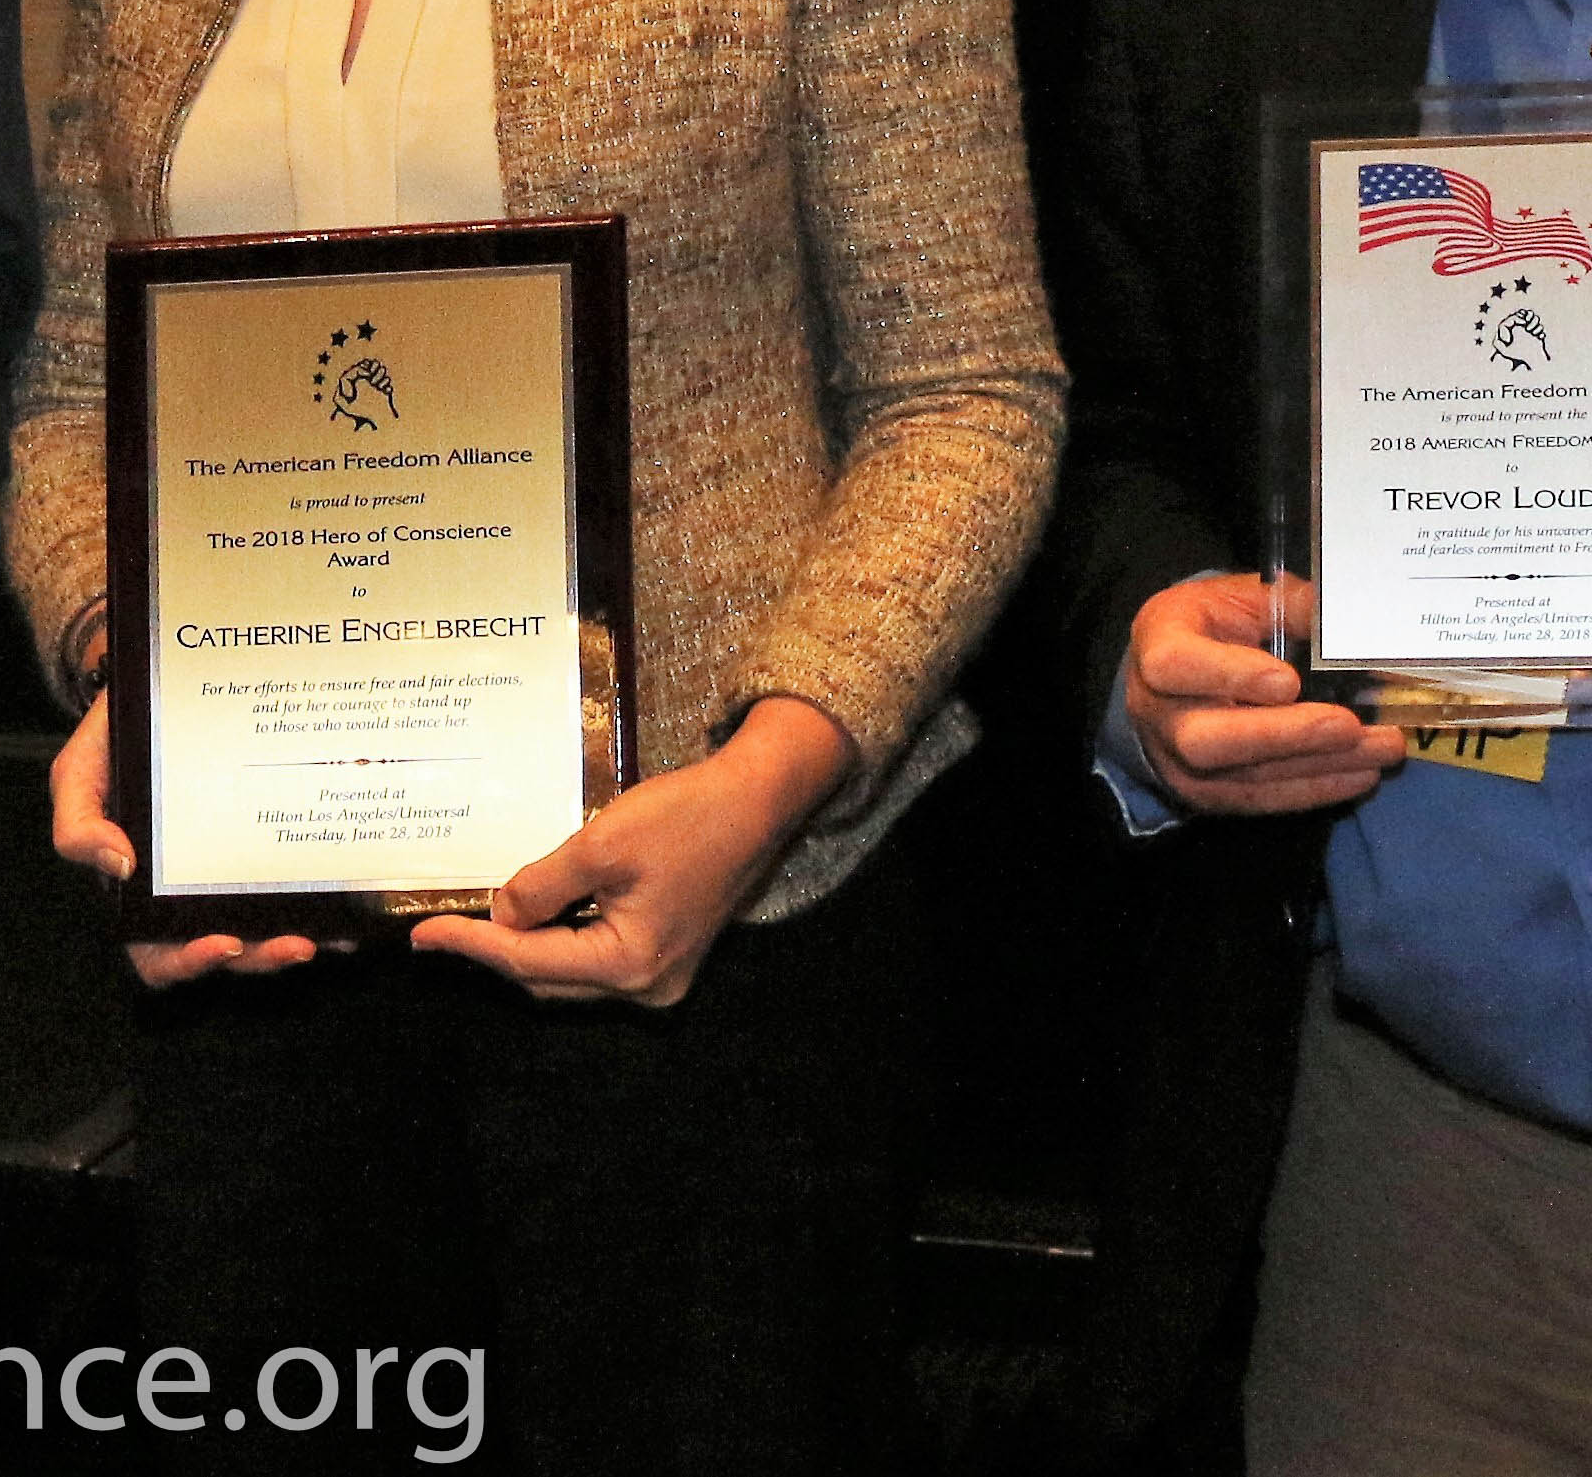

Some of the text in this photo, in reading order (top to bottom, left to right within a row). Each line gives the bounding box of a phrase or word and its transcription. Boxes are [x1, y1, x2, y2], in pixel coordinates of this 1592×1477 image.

[1359, 387, 1396, 402] The
[1401, 386, 1494, 401] American
[1501, 383, 1588, 399] Freedom
[1441, 407, 1588, 425] is proud to present the
[1370, 437, 1417, 452] 2018
[1421, 436, 1506, 451] AMERICAN
[184, 447, 533, 477] The American Freedom Alliance
[1505, 462, 1519, 474] to
[290, 492, 425, 513] is proud to present
[1383, 488, 1501, 511] TREVOR
[206, 523, 512, 549] The 2018 Hero of Conscience
[1417, 530, 1430, 539] in
[1434, 526, 1491, 541] gratitude
[1492, 526, 1511, 541] for
[1514, 525, 1533, 537] his
[327, 550, 390, 568] Award
[1402, 543, 1427, 556] and
[1427, 543, 1475, 558] fearless
[1476, 542, 1555, 555] commitment
[1558, 543, 1572, 554] to
[352, 585, 367, 598] to
[1474, 596, 1551, 608] Presented at
[1420, 613, 1461, 625] Hilton
[1465, 612, 1487, 625] Los
[176, 615, 546, 649] CATHERINE ENGELBRECHT
[1503, 629, 1533, 642] June
[1559, 628, 1591, 641] 2018
[201, 682, 225, 696] For
[227, 681, 252, 695] her
[253, 679, 297, 698] efforts
[319, 680, 367, 691] ensure
[368, 676, 396, 694] free
[398, 675, 425, 690] and
[427, 674, 455, 693] fair
[251, 700, 279, 716] and
[281, 699, 303, 718] for
[306, 698, 328, 712] her
[410, 693, 450, 709] stand
[453, 696, 472, 711] up
[272, 719, 309, 734] those
[312, 718, 342, 732] who
[345, 716, 390, 731] would
[319, 787, 406, 802] Presented at
[256, 804, 471, 825] Hilton Los Angeles/Universal
[352, 827, 385, 842] June
[417, 825, 452, 839] 2018
